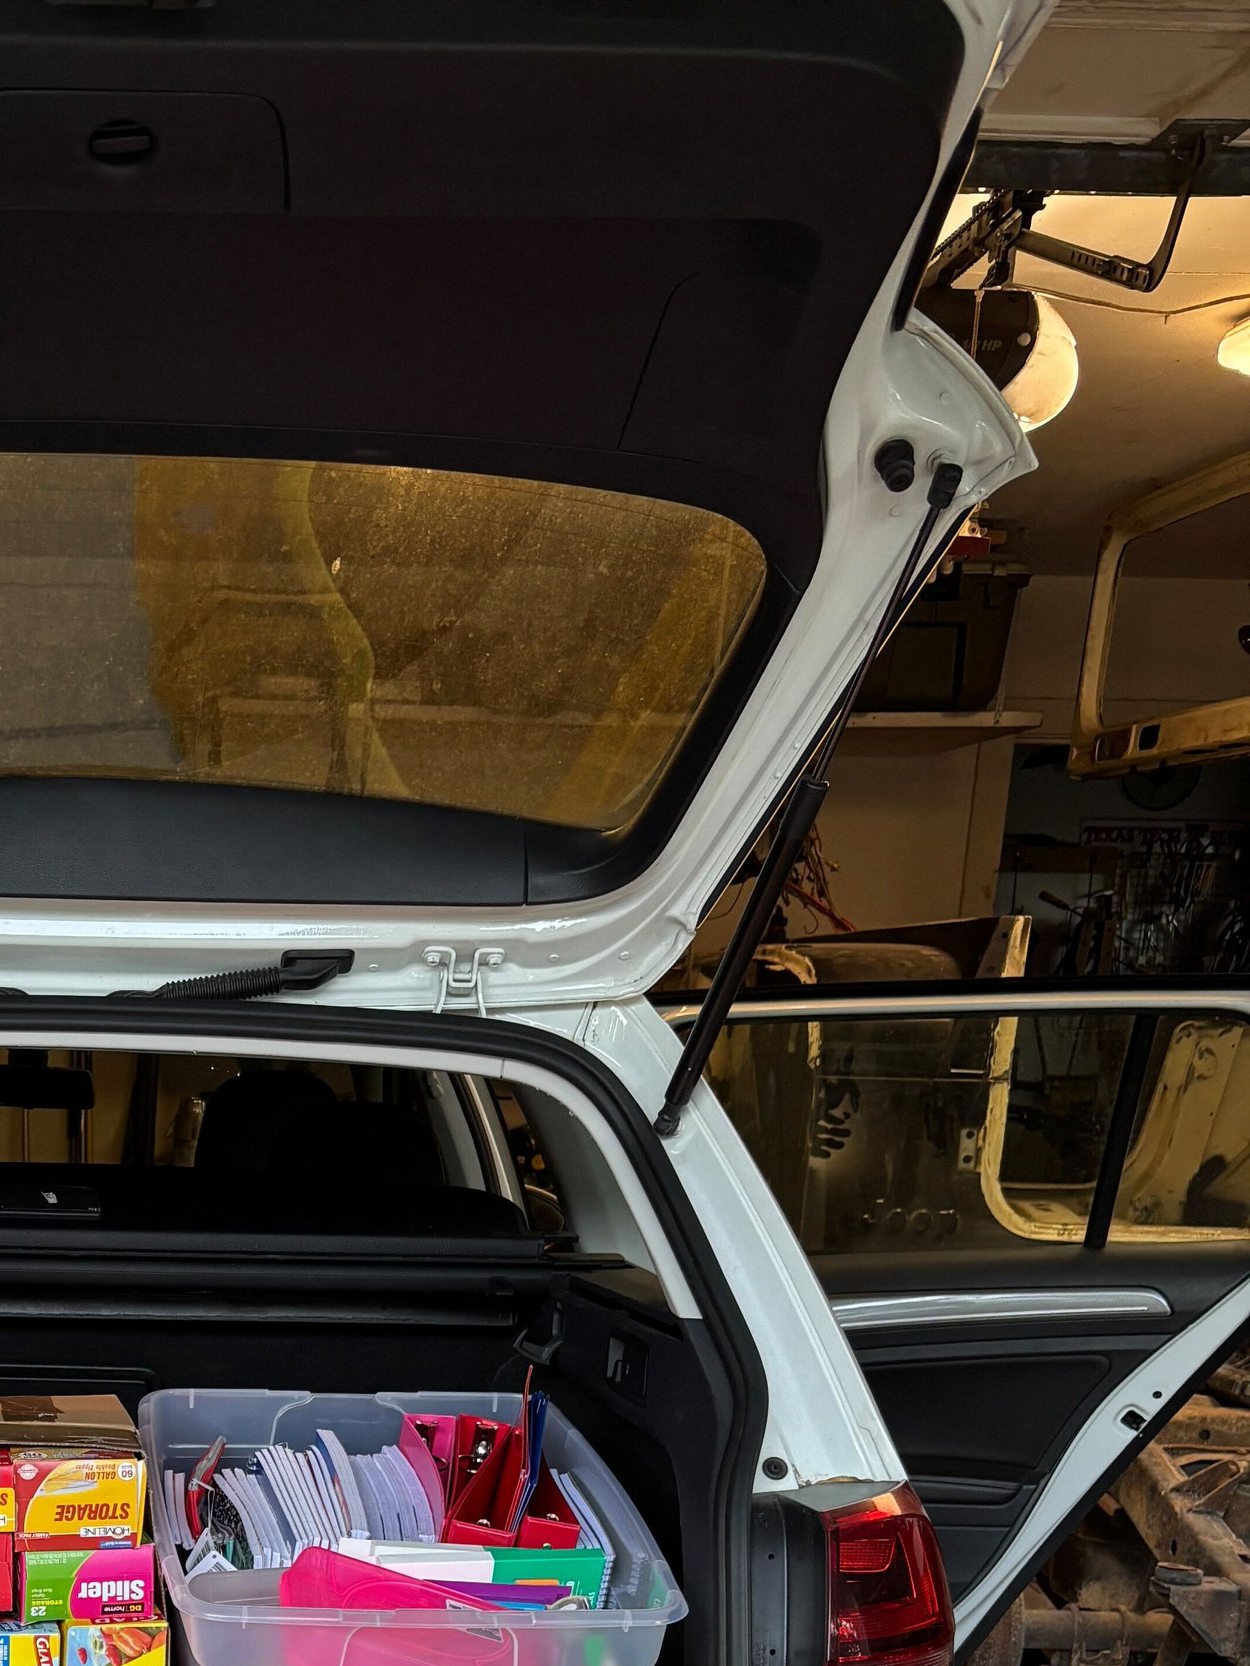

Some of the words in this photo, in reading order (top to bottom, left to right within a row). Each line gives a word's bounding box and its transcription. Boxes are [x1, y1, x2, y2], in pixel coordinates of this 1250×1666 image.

[84, 1471, 116, 1480] GALLON
[54, 1502, 130, 1522] STORAGE
[83, 1527, 130, 1536] HOMELINE
[78, 1580, 145, 1602] Slider
[30, 1606, 46, 1616] 23
[129, 1604, 142, 1613] DG
